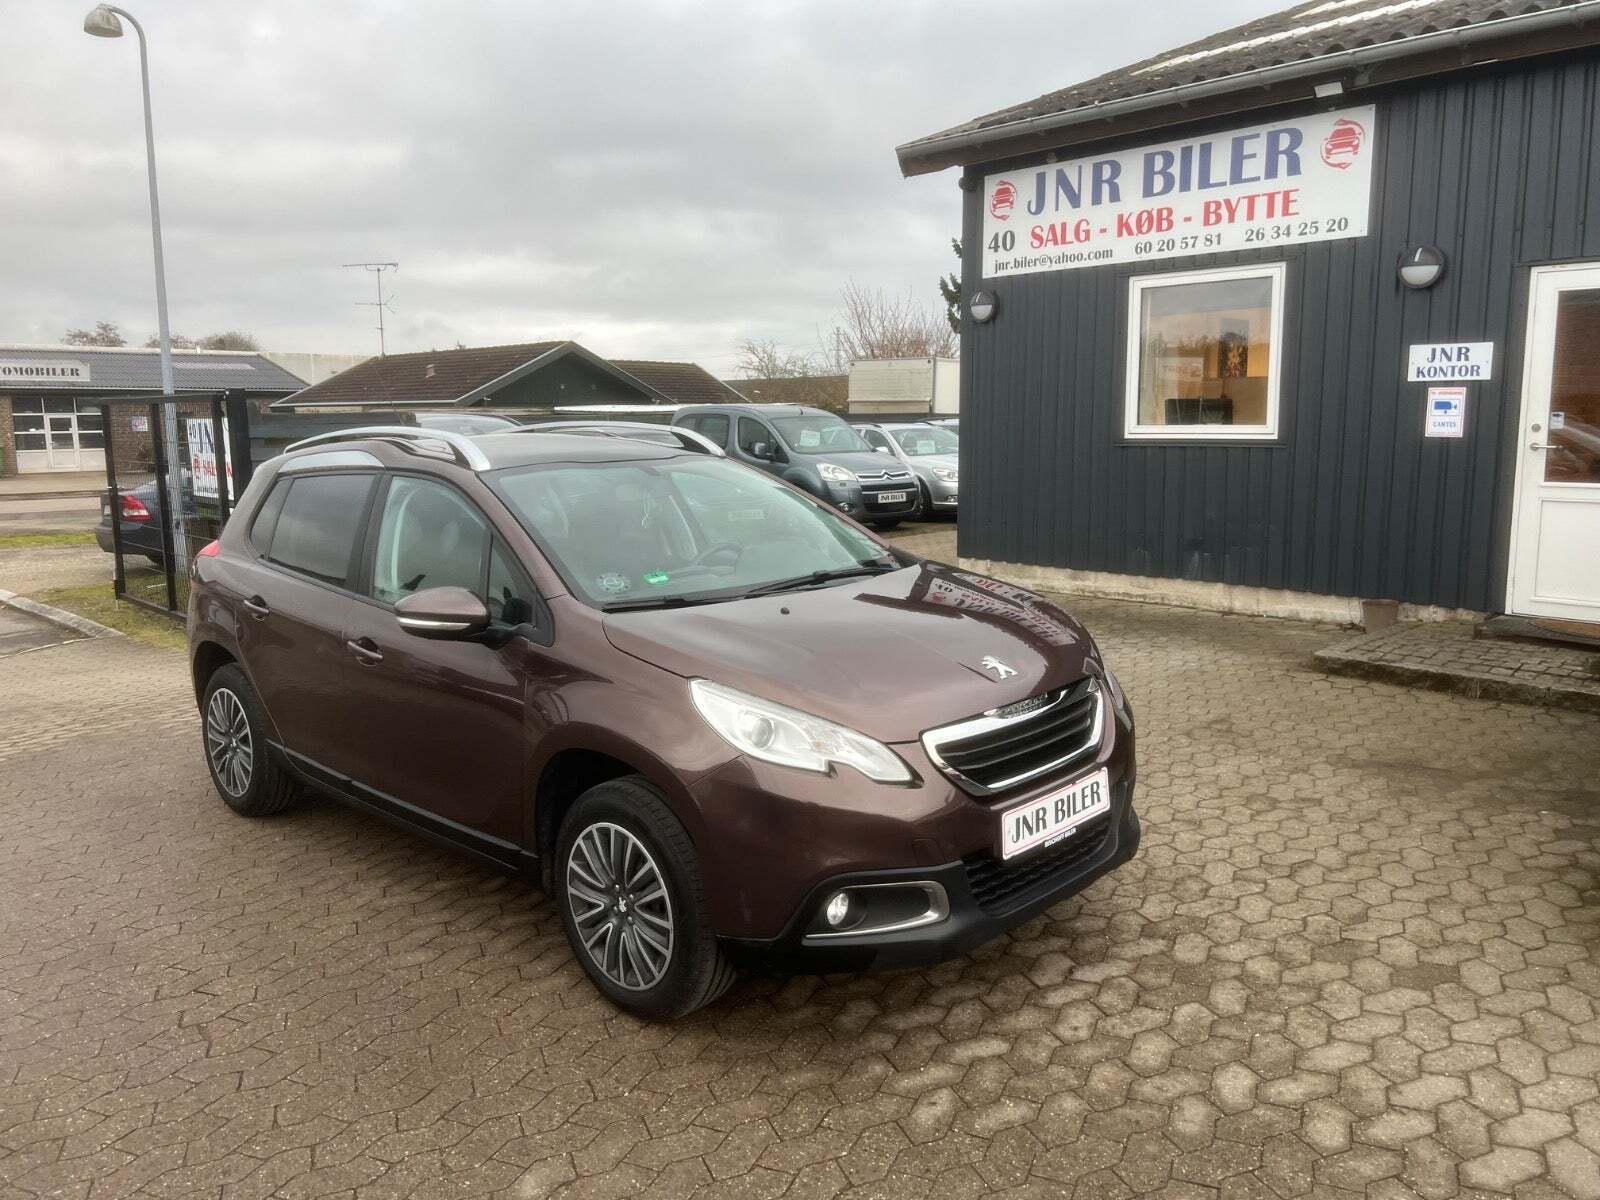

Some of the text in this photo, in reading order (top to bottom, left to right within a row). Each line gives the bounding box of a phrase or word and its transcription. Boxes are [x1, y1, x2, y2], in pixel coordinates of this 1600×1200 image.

[1026, 127, 1303, 215] JNR BILER
[1030, 218, 1091, 249] SALG
[1116, 207, 1175, 238] KØB
[1203, 188, 1300, 227] BYTTE
[1245, 217, 1349, 242] 26 34 25 20
[988, 230, 1016, 253] 40
[1135, 233, 1222, 255] 60 20 57 81
[994, 247, 1113, 274] jnr.biler@yahoo.com
[1427, 346, 1470, 363] JNR
[1416, 364, 1480, 378] KONTOR
[1012, 780, 1101, 843] JNR BILER
